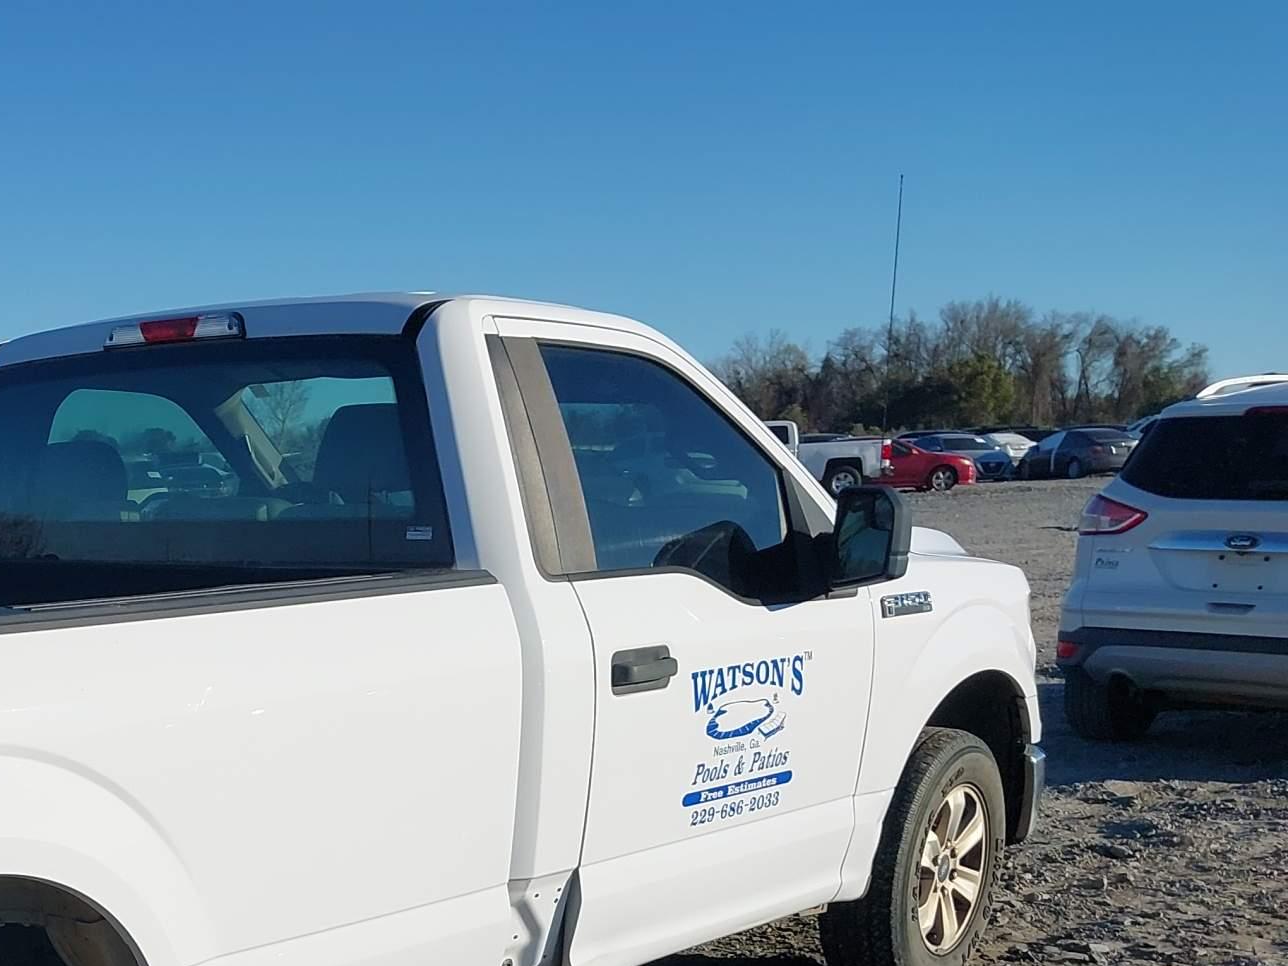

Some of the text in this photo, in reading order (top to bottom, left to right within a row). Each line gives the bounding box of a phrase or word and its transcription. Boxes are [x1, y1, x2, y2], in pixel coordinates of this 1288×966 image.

[691, 655, 804, 712] WATSON'S
[692, 748, 790, 786] Pools & Patios
[700, 778, 778, 802] Free Estimates
[690, 791, 780, 827] 229-686-2033
